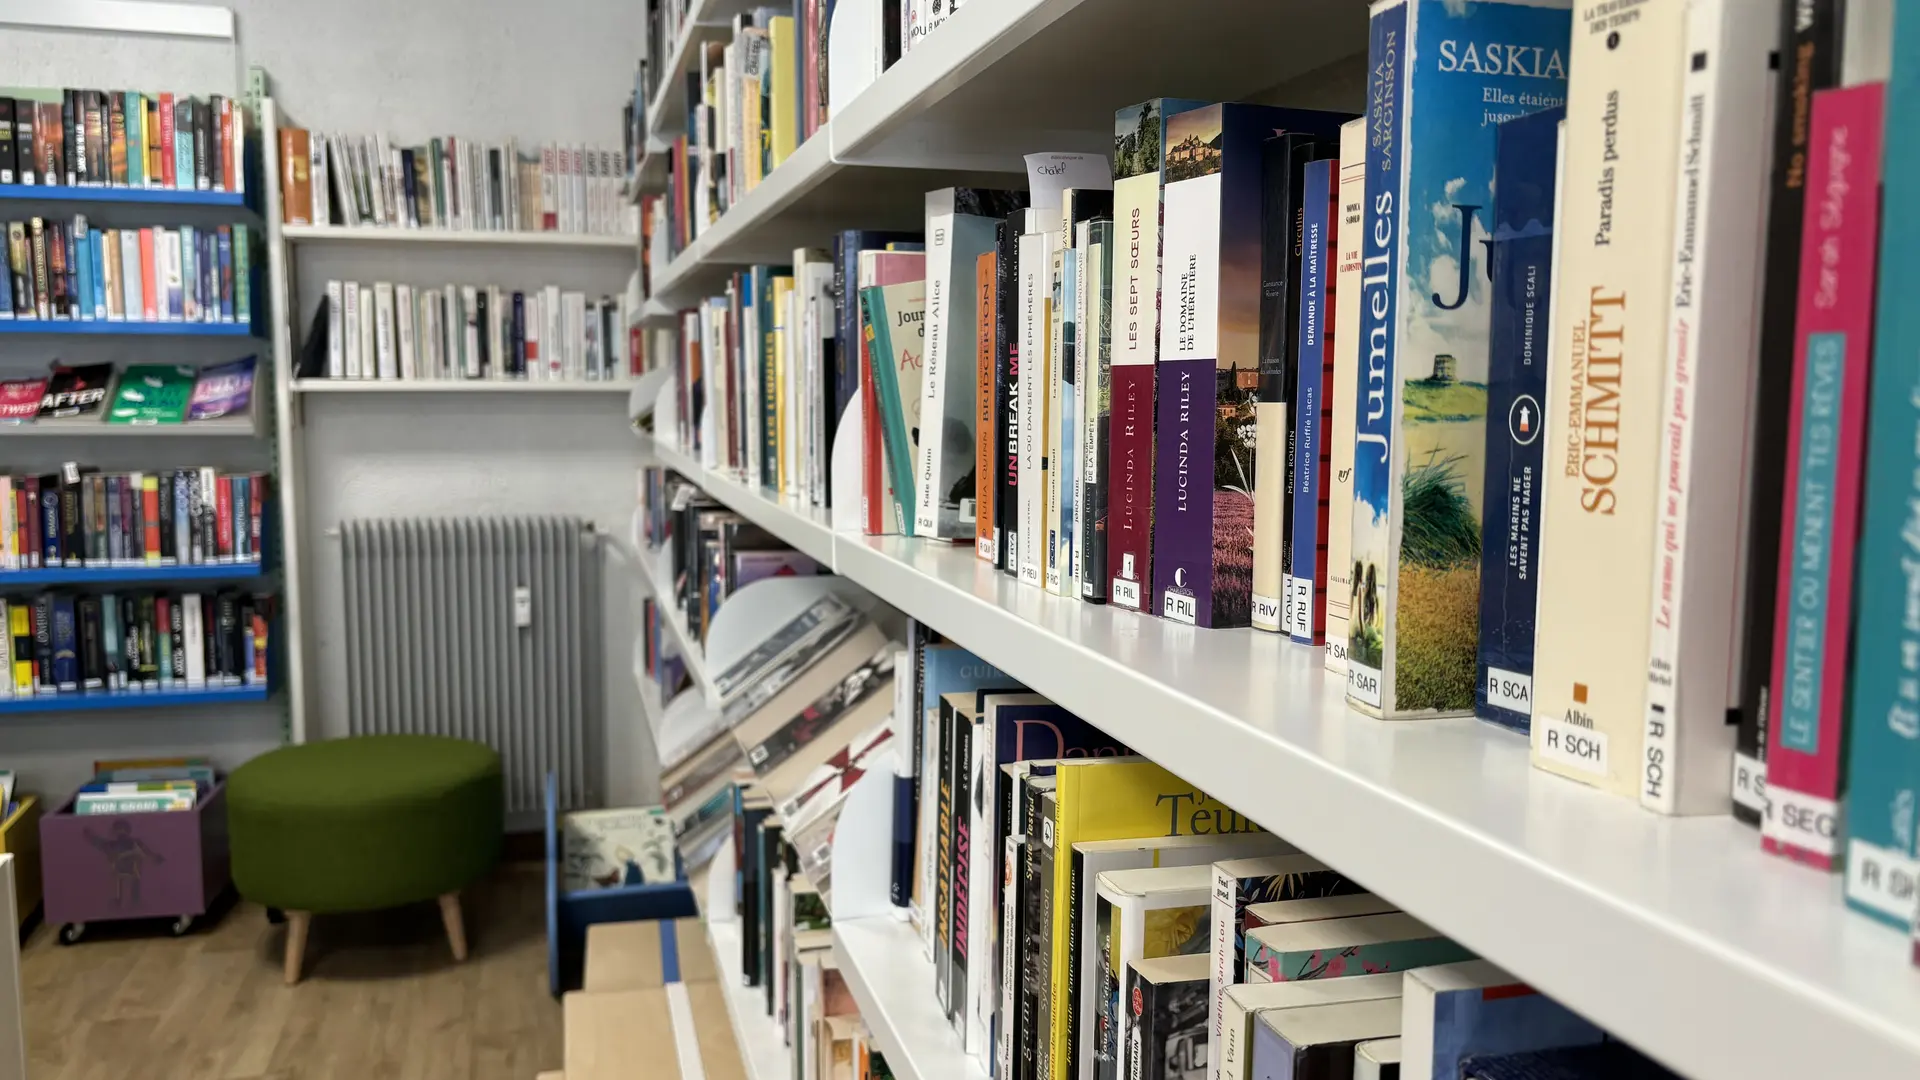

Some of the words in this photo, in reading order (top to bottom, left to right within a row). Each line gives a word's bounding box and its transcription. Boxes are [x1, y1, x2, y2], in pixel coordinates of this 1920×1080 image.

[1438, 39, 1569, 80] SASKIA
[1373, 63, 1384, 148] SASKIA
[1382, 31, 1396, 172] SARGINSON
[1483, 87, 1515, 105] Elles
[1602, 90, 1619, 163] perdus
[1345, 215, 1360, 225] SABOLO
[1346, 203, 1361, 213] MONICA
[1594, 166, 1615, 247] Paradis
[1131, 207, 1140, 269] SŒURS
[1295, 207, 1304, 257] Circulus
[1308, 222, 1318, 275] MAÎTRESSE
[1310, 276, 1316, 288] LA
[1340, 262, 1362, 273] CLANDESTIN
[1527, 265, 1537, 299] SCALI
[932, 280, 941, 319] Alice
[1130, 276, 1138, 316] SEPT
[1179, 273, 1188, 334] DOMAINE
[1129, 321, 1137, 350] LES
[1307, 299, 1316, 346] DEMANDE
[1356, 190, 1393, 464] Jumelles
[1524, 305, 1536, 366] DOMINIQUE
[929, 324, 939, 376] Réseau
[1009, 343, 1019, 376] ME
[1179, 337, 1186, 351] LE
[1187, 334, 1194, 351] DE
[40, 387, 105, 409] AFTER
[928, 380, 936, 399] Le
[1179, 371, 1190, 423] RILEY
[1305, 386, 1313, 416] Lacas
[1565, 319, 1586, 478] ERIC-EMMANUEL
[1580, 285, 1627, 516] SCHMITT
[1126, 380, 1136, 437] RILEY
[1008, 382, 1018, 486] UNBREAK
[924, 448, 932, 482] Quinn
[1088, 456, 1094, 468] LA
[1088, 469, 1094, 482] DE
[1178, 428, 1189, 512] LUCINDA
[1303, 451, 1311, 493] Béatrice
[1124, 448, 1134, 531] LUCINDA
[1513, 476, 1522, 491] NE
[1523, 466, 1532, 505] NAGER
[918, 517, 923, 527] R
[923, 518, 932, 528] QUI
[1511, 496, 1521, 542] MARINS
[1521, 509, 1530, 532] PAS
[1509, 545, 1518, 567] LES
[1519, 535, 1529, 580] SAVENT
[1026, 567, 1037, 580] REU
[1298, 585, 1307, 596] R
[1115, 586, 1121, 596] R
[1123, 587, 1135, 600] RIL
[1166, 597, 1174, 612] R
[1177, 599, 1194, 618] RIL
[1258, 602, 1277, 618] RIV
[1296, 601, 1307, 633] RUF
[1325, 641, 1332, 656] R
[1349, 669, 1355, 685] R
[1356, 673, 1378, 695] SAR
[1489, 677, 1498, 695] R
[1502, 680, 1528, 702] SCA
[1565, 708, 1594, 730] Albin
[1650, 720, 1664, 739] R
[1547, 730, 1558, 749] R
[1565, 735, 1601, 762] SCH
[1646, 746, 1664, 799] SCH
[1737, 767, 1749, 789] R
[938, 777, 950, 950] INSATIABLE
[1026, 842, 1034, 881] Sylvie
[1860, 857, 1883, 888] R
[955, 815, 970, 961] INDÉCISE
[1216, 887, 1229, 900] good
[1217, 875, 1229, 889] Feel
[1042, 888, 1050, 943] Tesson
[1217, 920, 1225, 983] Sarah-Lou
[1023, 934, 1033, 1063] gamines
[1040, 951, 1049, 1013] Sylvain
[1101, 1032, 1109, 1062] Nous
[1227, 1028, 1236, 1063] Vann
